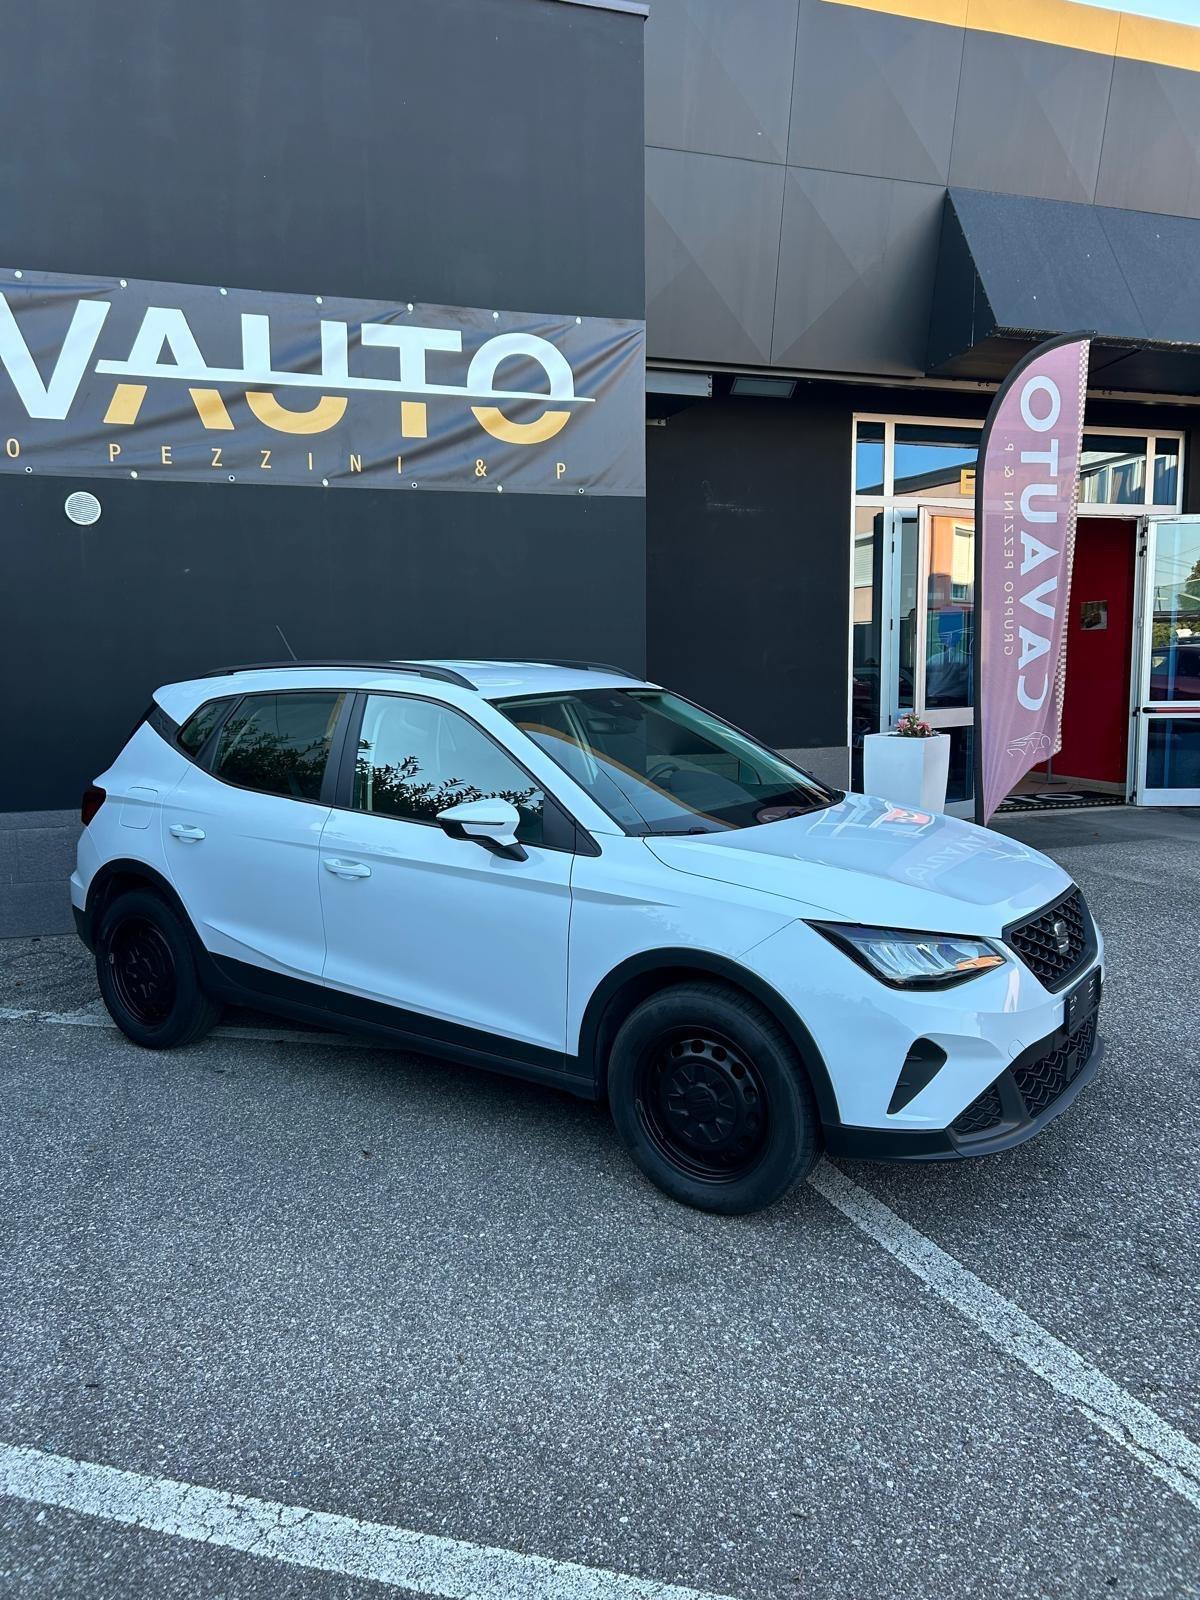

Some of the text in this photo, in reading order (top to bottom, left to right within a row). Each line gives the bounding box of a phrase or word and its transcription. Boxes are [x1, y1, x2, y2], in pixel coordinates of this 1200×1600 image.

[0, 292, 577, 445] VAUTO
[108, 443, 402, 474] PEZZINI
[475, 459, 487, 477] &
